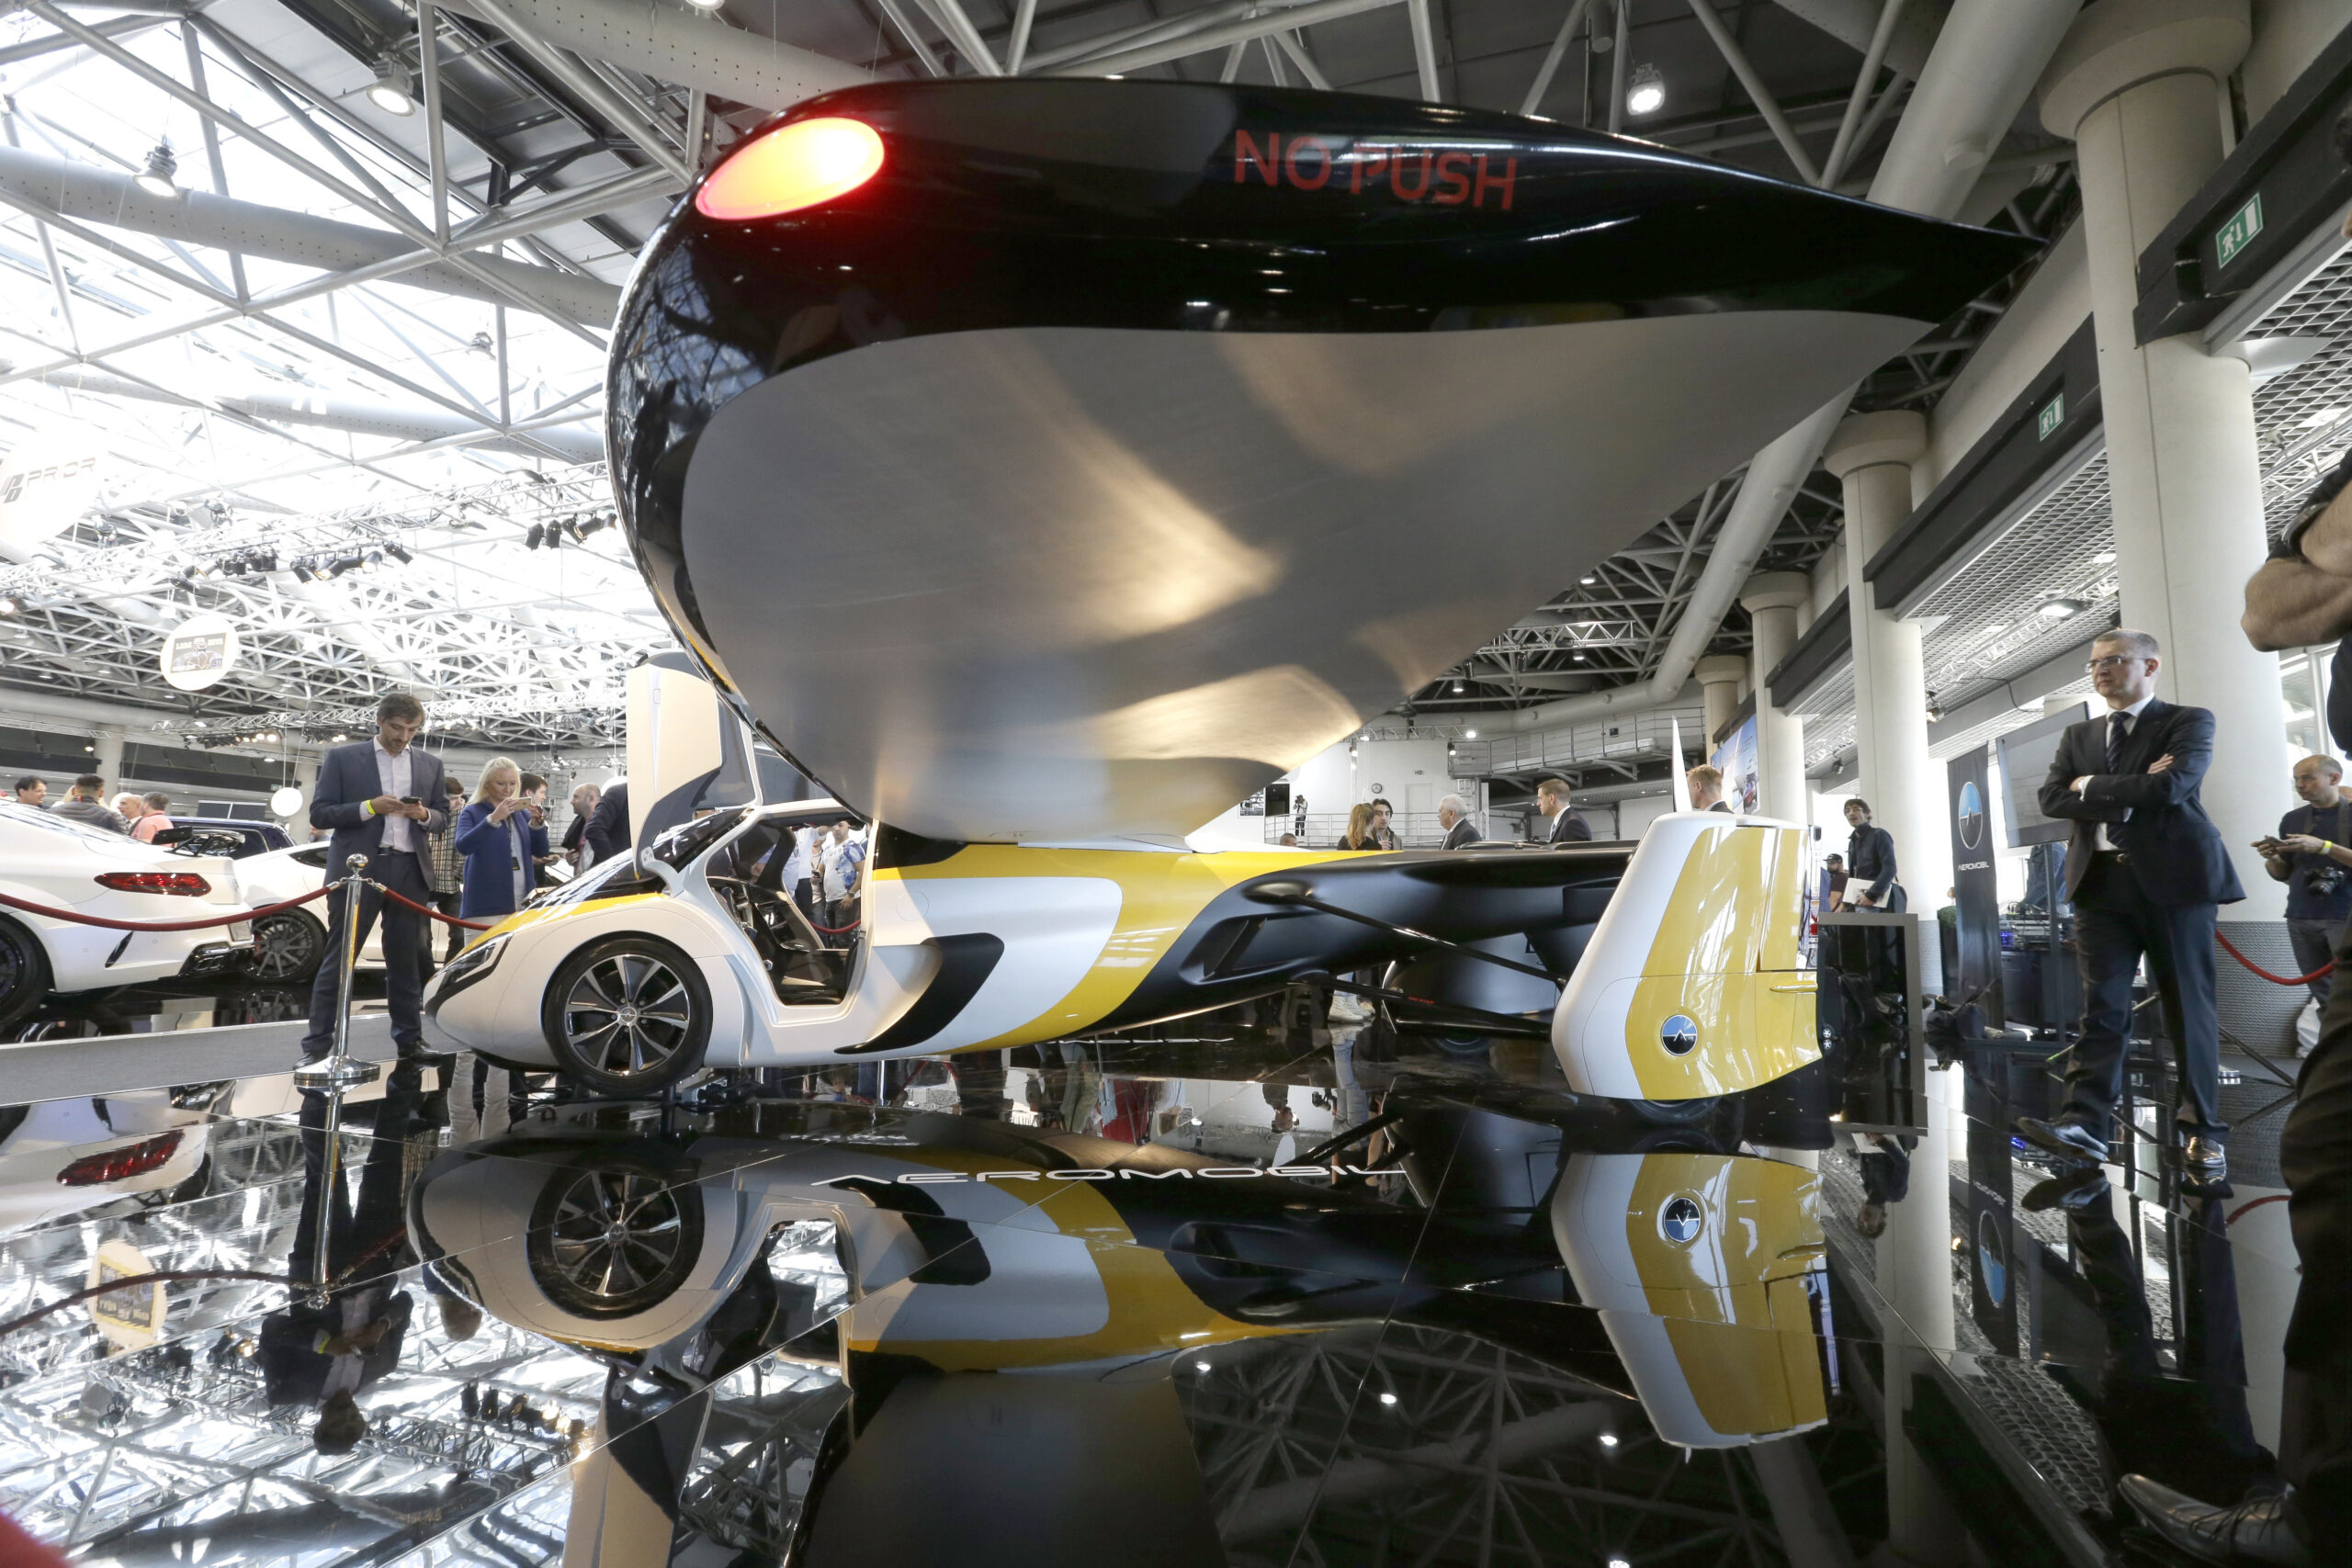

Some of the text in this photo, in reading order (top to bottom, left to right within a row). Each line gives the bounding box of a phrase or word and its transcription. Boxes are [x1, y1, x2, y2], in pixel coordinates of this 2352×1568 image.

[1234, 129, 1517, 211] NO PUSH
[27, 457, 96, 487] PROR
[810, 1165, 1408, 1186] AEROMOBIL
